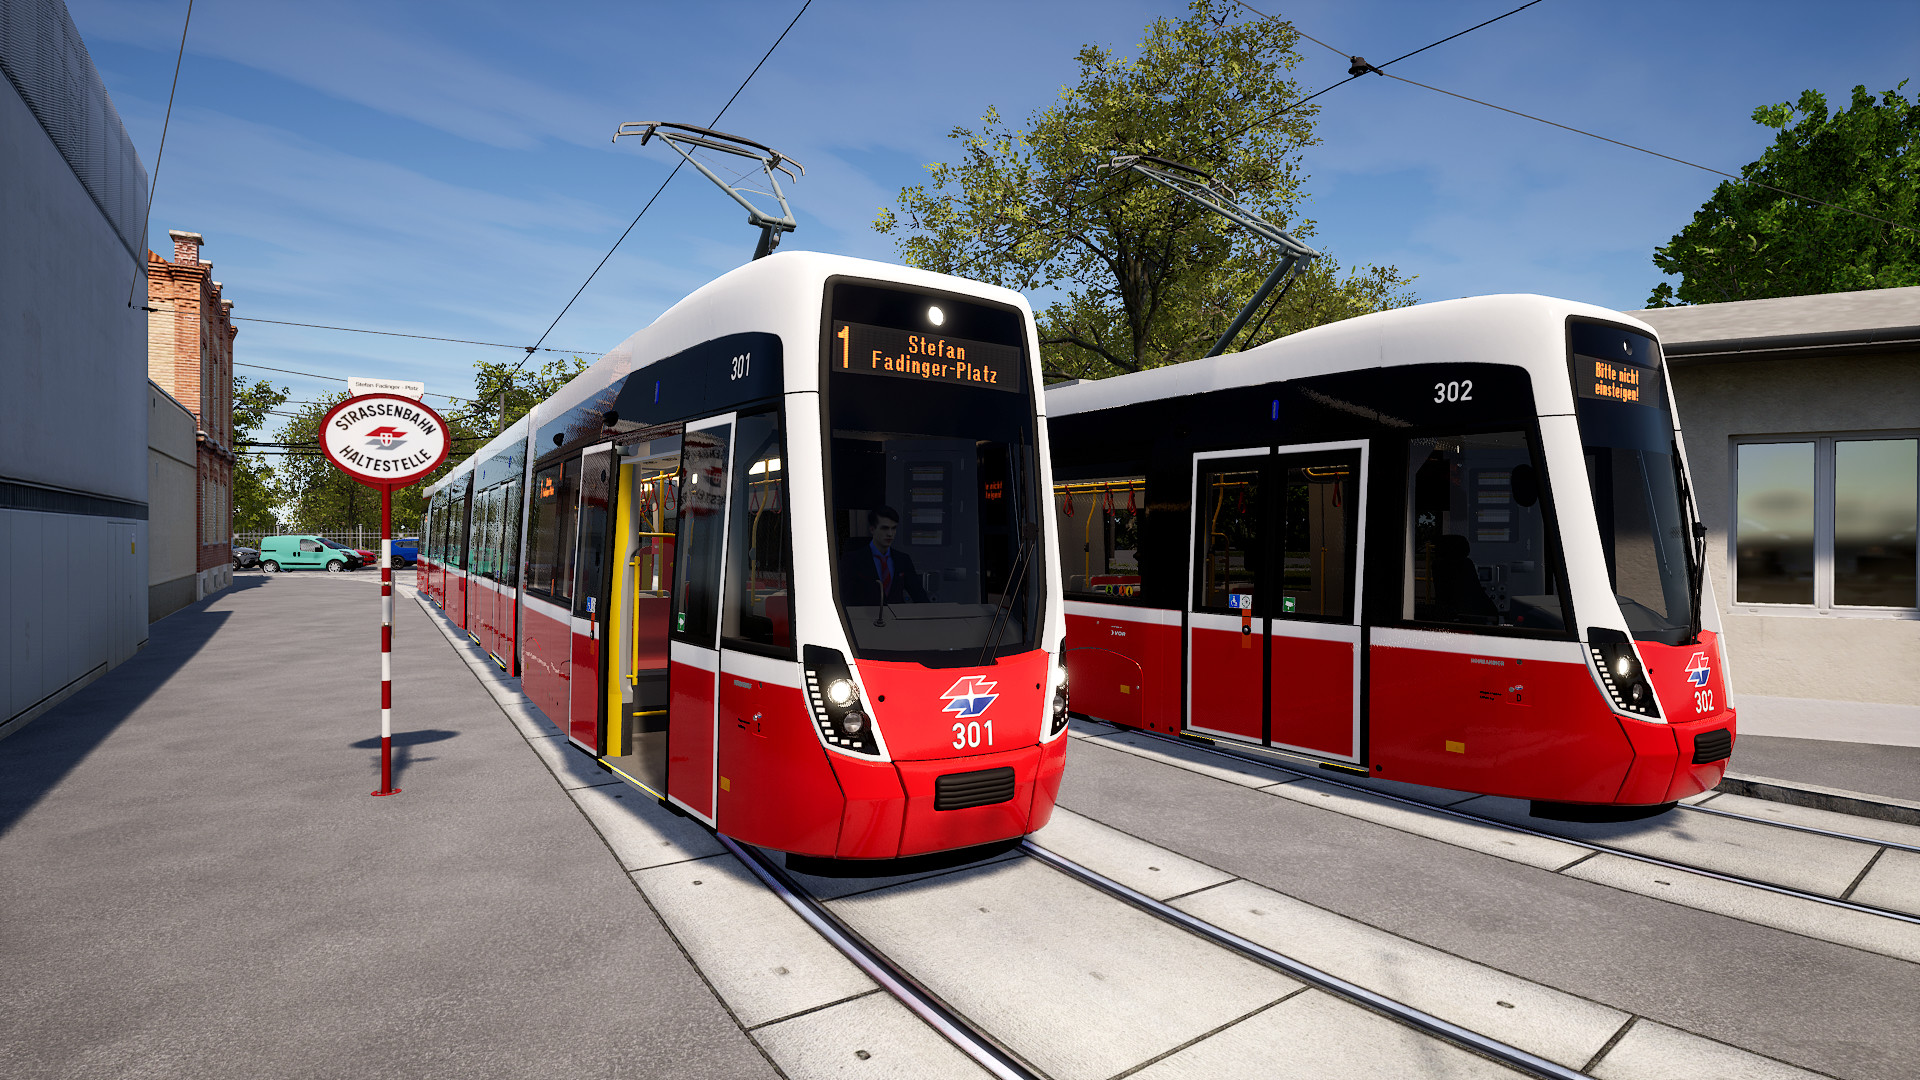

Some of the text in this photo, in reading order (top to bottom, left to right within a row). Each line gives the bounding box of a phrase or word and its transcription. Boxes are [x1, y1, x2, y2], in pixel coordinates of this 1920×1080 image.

[837, 325, 850, 369] 1
[908, 335, 966, 361] Stefan
[730, 352, 751, 381] 301
[871, 350, 998, 384] Fadinger-Platz
[1595, 361, 1639, 386] Bitte nicht
[1433, 379, 1473, 404] 302
[1594, 379, 1639, 403] einsteigen!
[335, 404, 437, 436] STRASSENBAHN
[339, 445, 432, 472] HALTESTELLE
[1694, 689, 1715, 714] 302
[951, 719, 994, 750] 301
